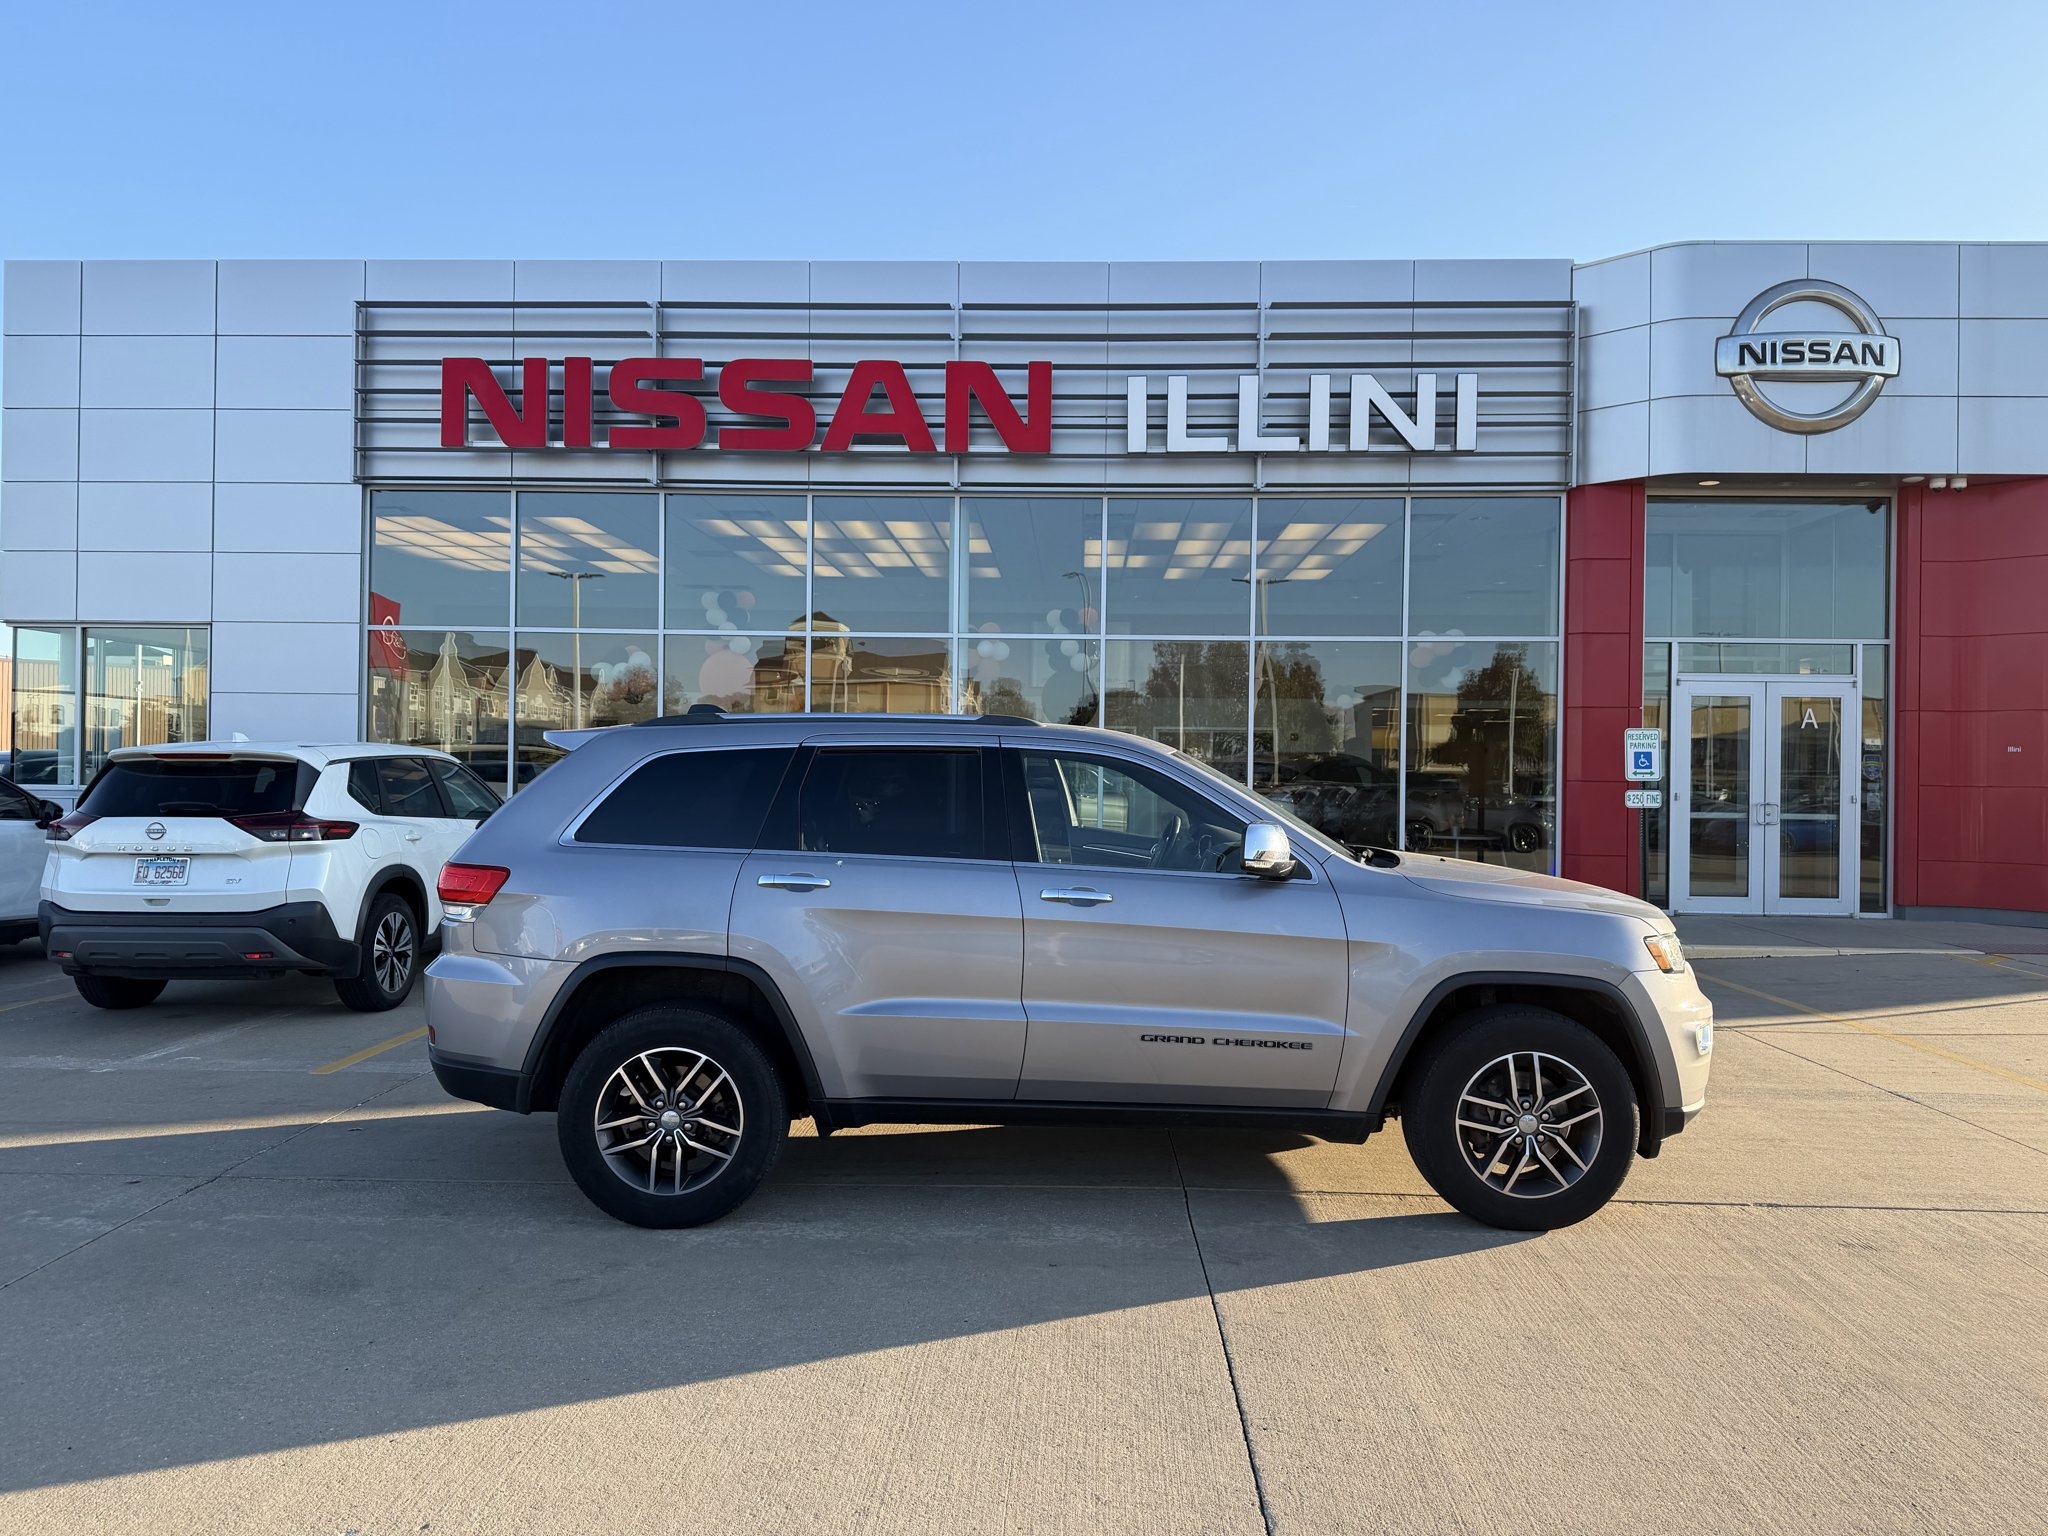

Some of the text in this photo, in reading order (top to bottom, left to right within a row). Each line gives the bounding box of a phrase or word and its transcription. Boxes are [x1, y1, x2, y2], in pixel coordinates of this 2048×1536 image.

[1738, 340, 1886, 367] NISSAN
[441, 356, 1478, 453] NISSAN ILLINI
[1801, 708, 1819, 729] A
[1627, 733, 1658, 741] RESERVED
[1629, 742, 1657, 750] PARKING
[1627, 794, 1660, 804] $250 FINE
[154, 865, 185, 879] 62568
[1140, 1034, 1313, 1050] GRAND CHEROKEE
